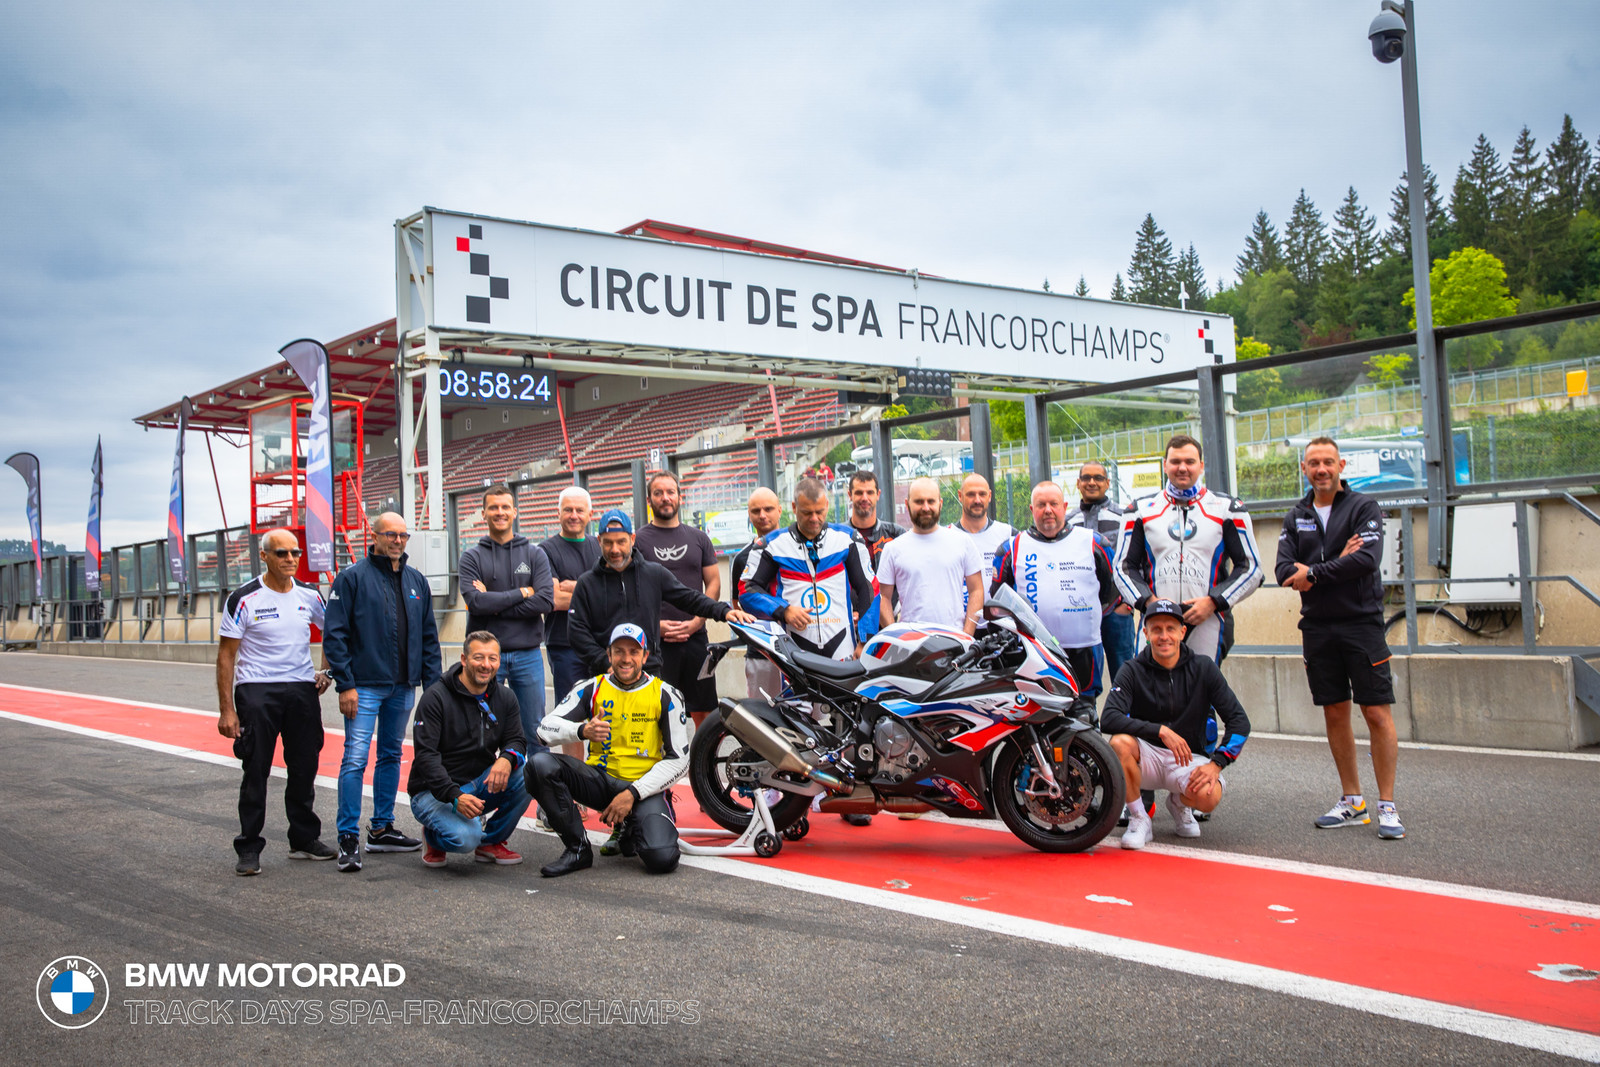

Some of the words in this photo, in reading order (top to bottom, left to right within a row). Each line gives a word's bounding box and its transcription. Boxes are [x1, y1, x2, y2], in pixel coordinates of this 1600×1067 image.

[560, 262, 732, 322] CIRCUIT
[747, 284, 798, 329] DE
[811, 292, 883, 338] SPA
[440, 368, 551, 402] 08:58:24
